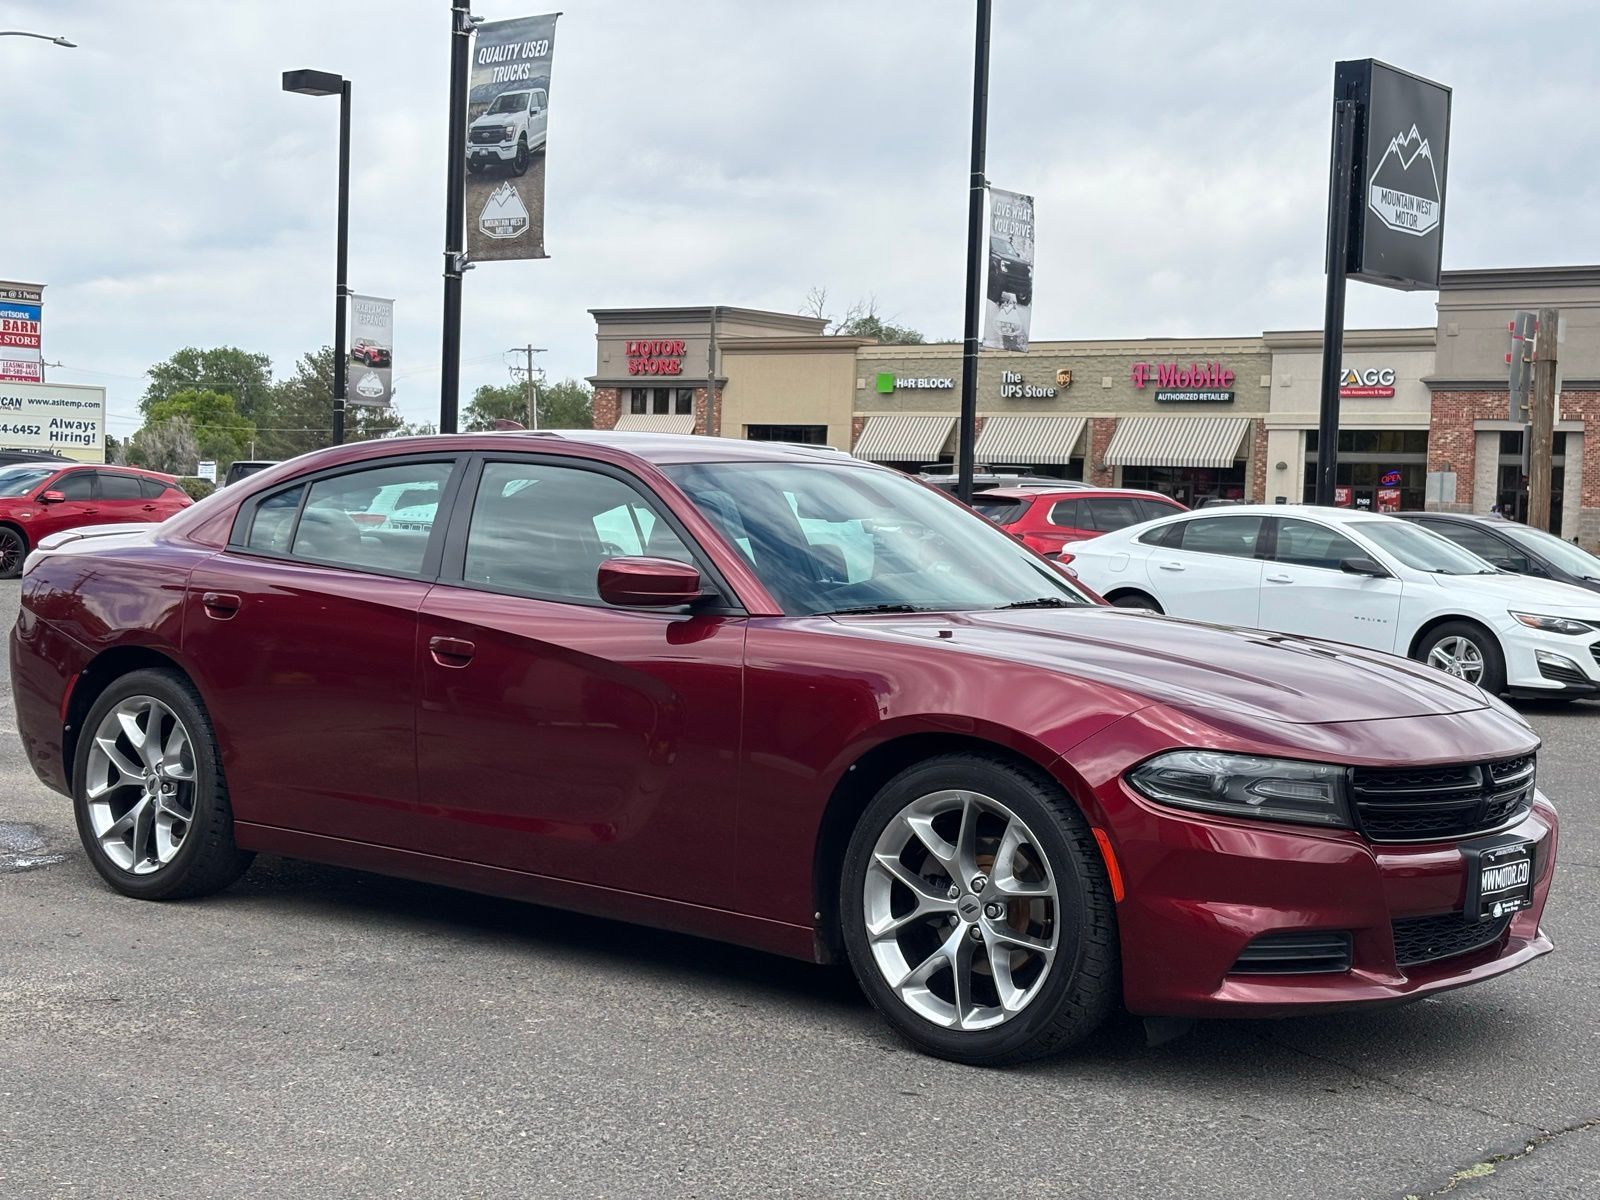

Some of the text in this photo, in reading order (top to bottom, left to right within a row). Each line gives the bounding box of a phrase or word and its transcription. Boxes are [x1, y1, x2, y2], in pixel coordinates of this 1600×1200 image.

[478, 40, 549, 65] QUALITY USED
[492, 63, 531, 83] TRUCKS
[1381, 189, 1433, 216] MOUNTAIN WEST
[993, 201, 1031, 222] LOVE WHAT
[1395, 209, 1418, 228] MOTOR
[510, 218, 523, 226] WEST
[994, 217, 1031, 238] YOU DRIVE
[8, 290, 18, 299] @
[0, 310, 30, 319] ertsons
[2, 319, 38, 334] BARN
[4, 335, 38, 346] STORE
[625, 339, 686, 358] LIQUOR
[3, 361, 25, 370] LEASING
[628, 357, 683, 376] STORE
[896, 378, 953, 389] H&R BLOCK
[1001, 370, 1022, 383] The
[1057, 373, 1070, 385] ups
[1340, 368, 1395, 386] ZAGG
[1000, 384, 1055, 398] UPS Store
[1157, 393, 1229, 401] AUTHORIZED RETAILER
[0, 396, 23, 407] CAN
[27, 398, 101, 409] www.asitemp.com
[0, 423, 41, 435] 4-6452
[49, 418, 96, 433] Always
[49, 431, 96, 446] Hiring!
[1381, 473, 1402, 485] OPEN
[1480, 862, 1528, 892] MWMOTOR.CO
